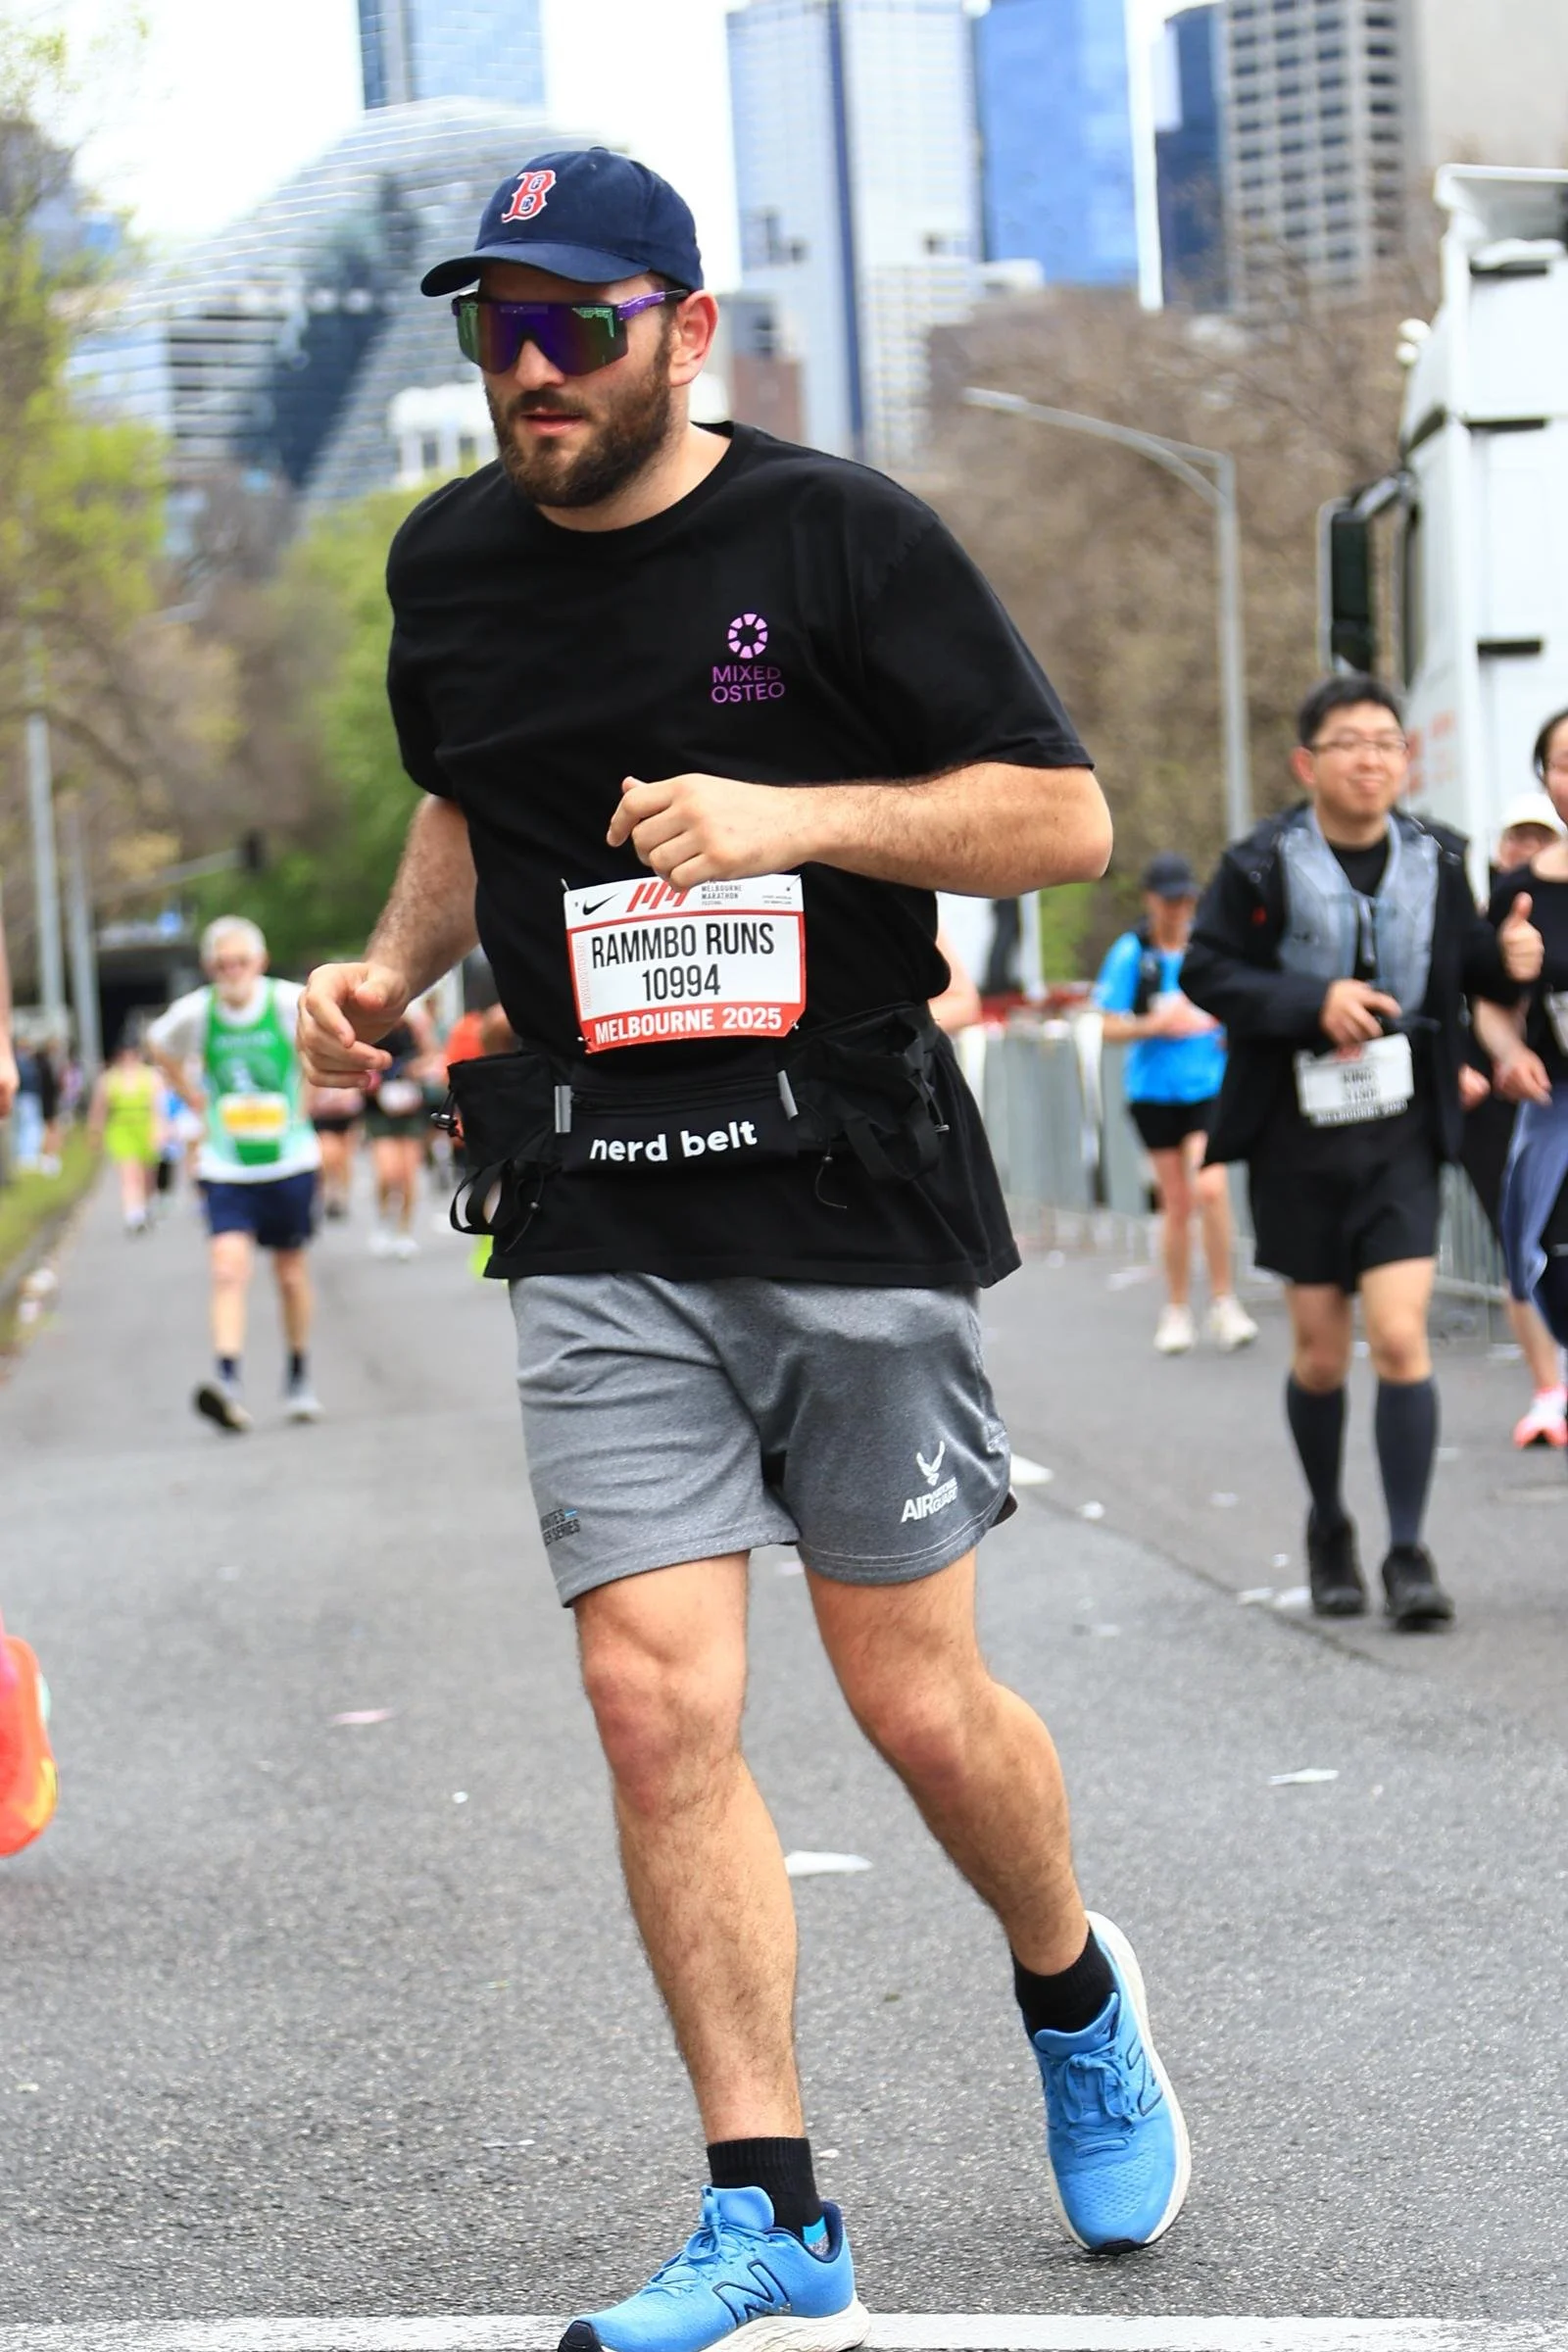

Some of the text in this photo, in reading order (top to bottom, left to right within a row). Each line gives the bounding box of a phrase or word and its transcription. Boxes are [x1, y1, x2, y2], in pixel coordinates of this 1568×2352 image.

[501, 170, 557, 223] B
[711, 682, 785, 704] OSTEO
[712, 665, 781, 683] MIXED
[592, 922, 774, 968] RAMMBO RUNS
[642, 963, 721, 1002] 10994
[595, 1006, 782, 1045] MELBOURNE 2025
[589, 1120, 758, 1162] nerd belt
[901, 1492, 935, 1523] AIR
